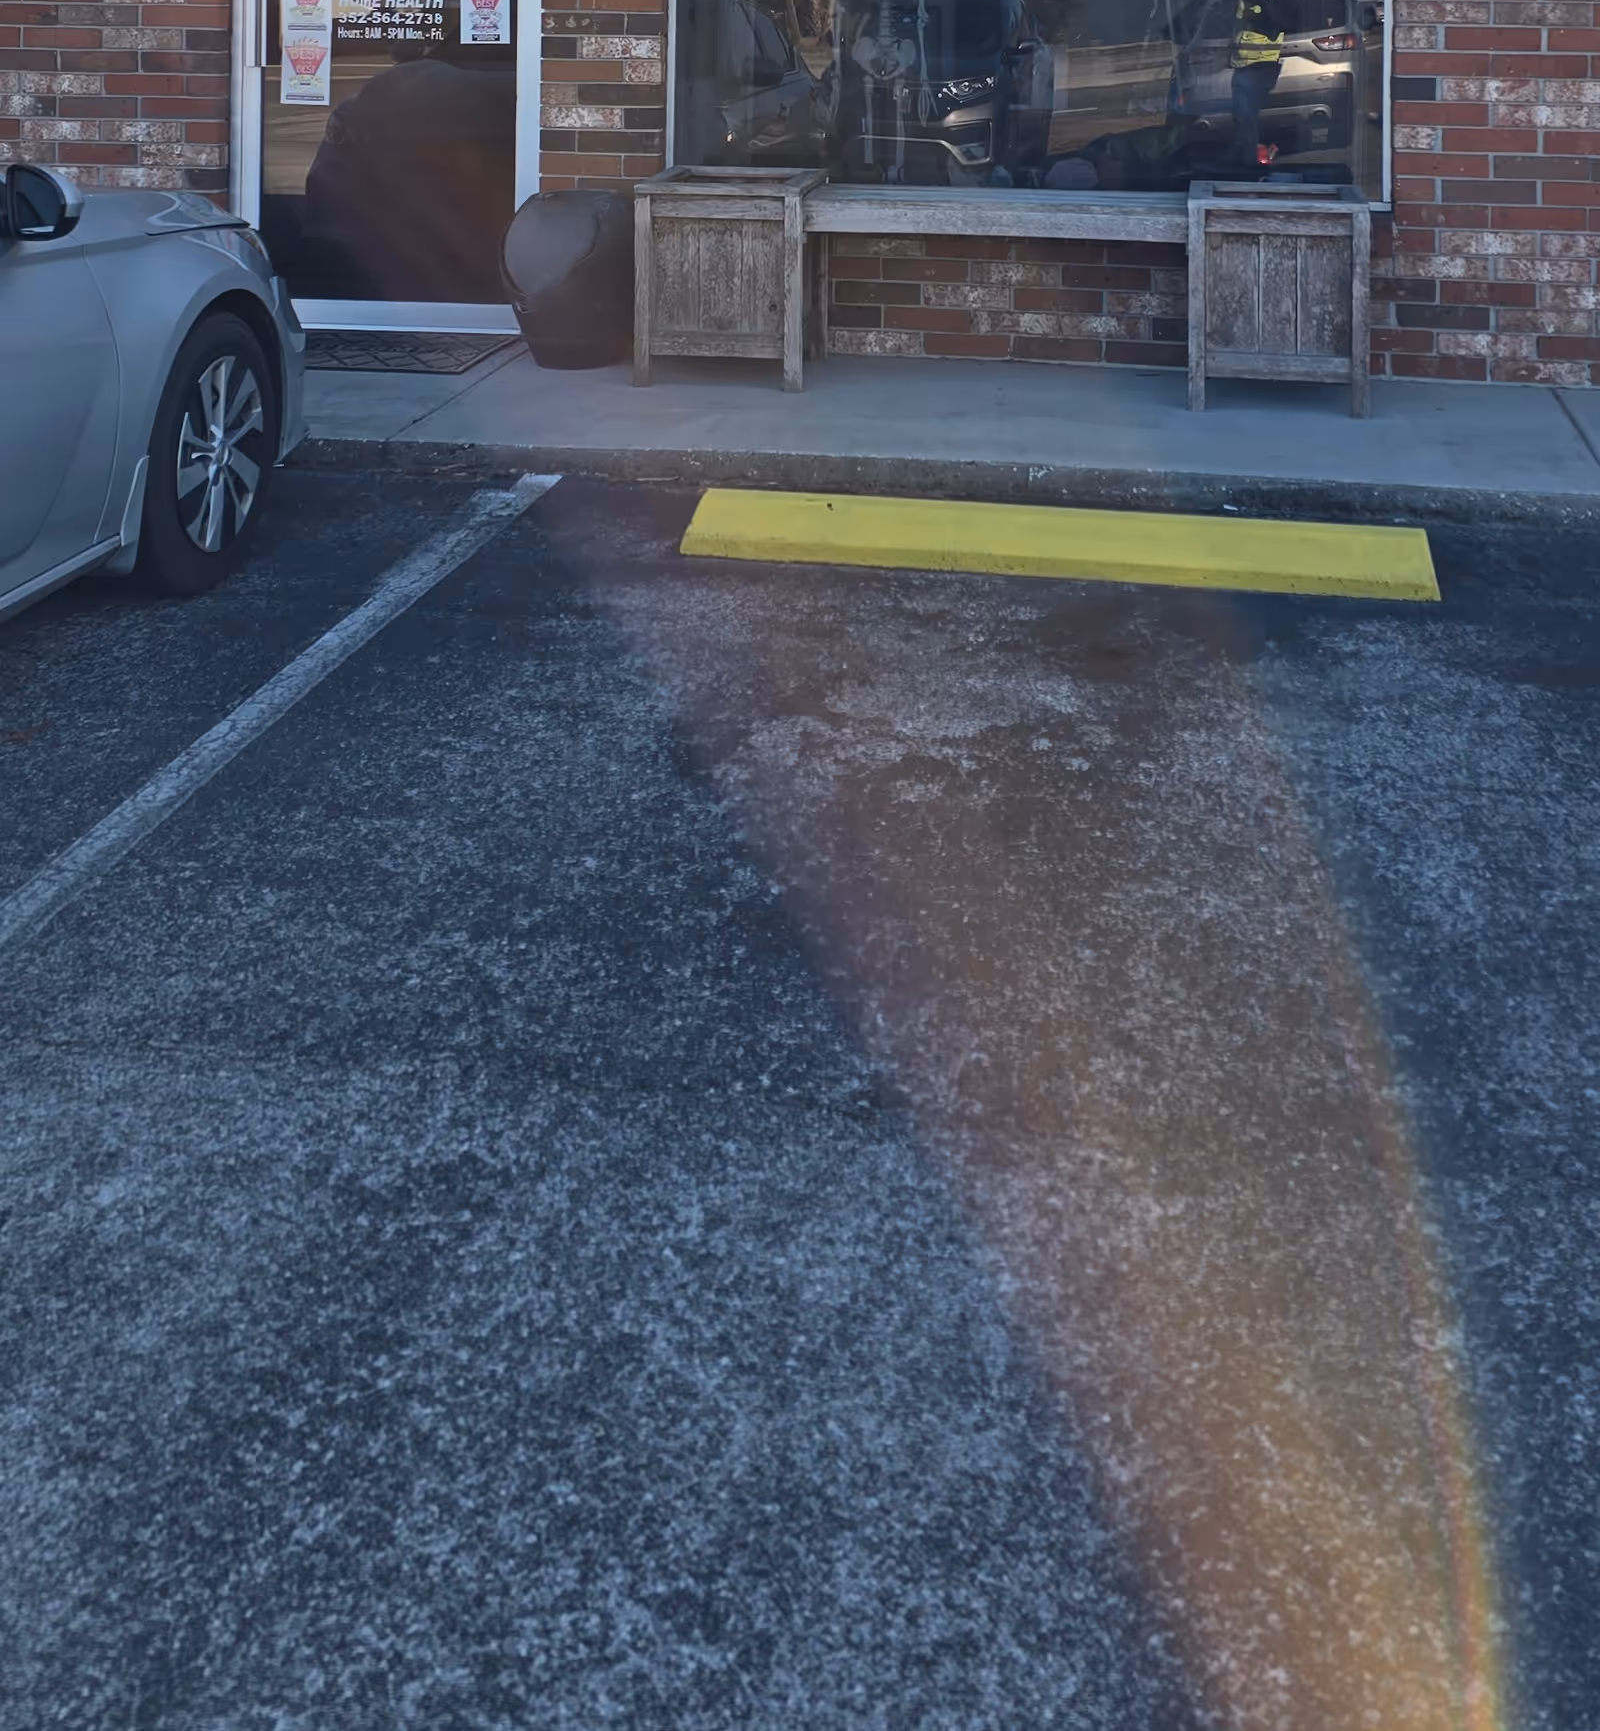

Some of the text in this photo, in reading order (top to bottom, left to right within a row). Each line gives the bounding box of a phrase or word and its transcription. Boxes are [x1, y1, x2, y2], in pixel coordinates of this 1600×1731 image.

[475, 0, 496, 8] BEST
[338, 12, 443, 25] 352-564-2738
[337, 26, 364, 39] Hours:
[364, 27, 382, 39] 8AM
[387, 27, 405, 40] 5PM
[405, 28, 425, 40] Mon.
[430, 28, 444, 41] Fri.
